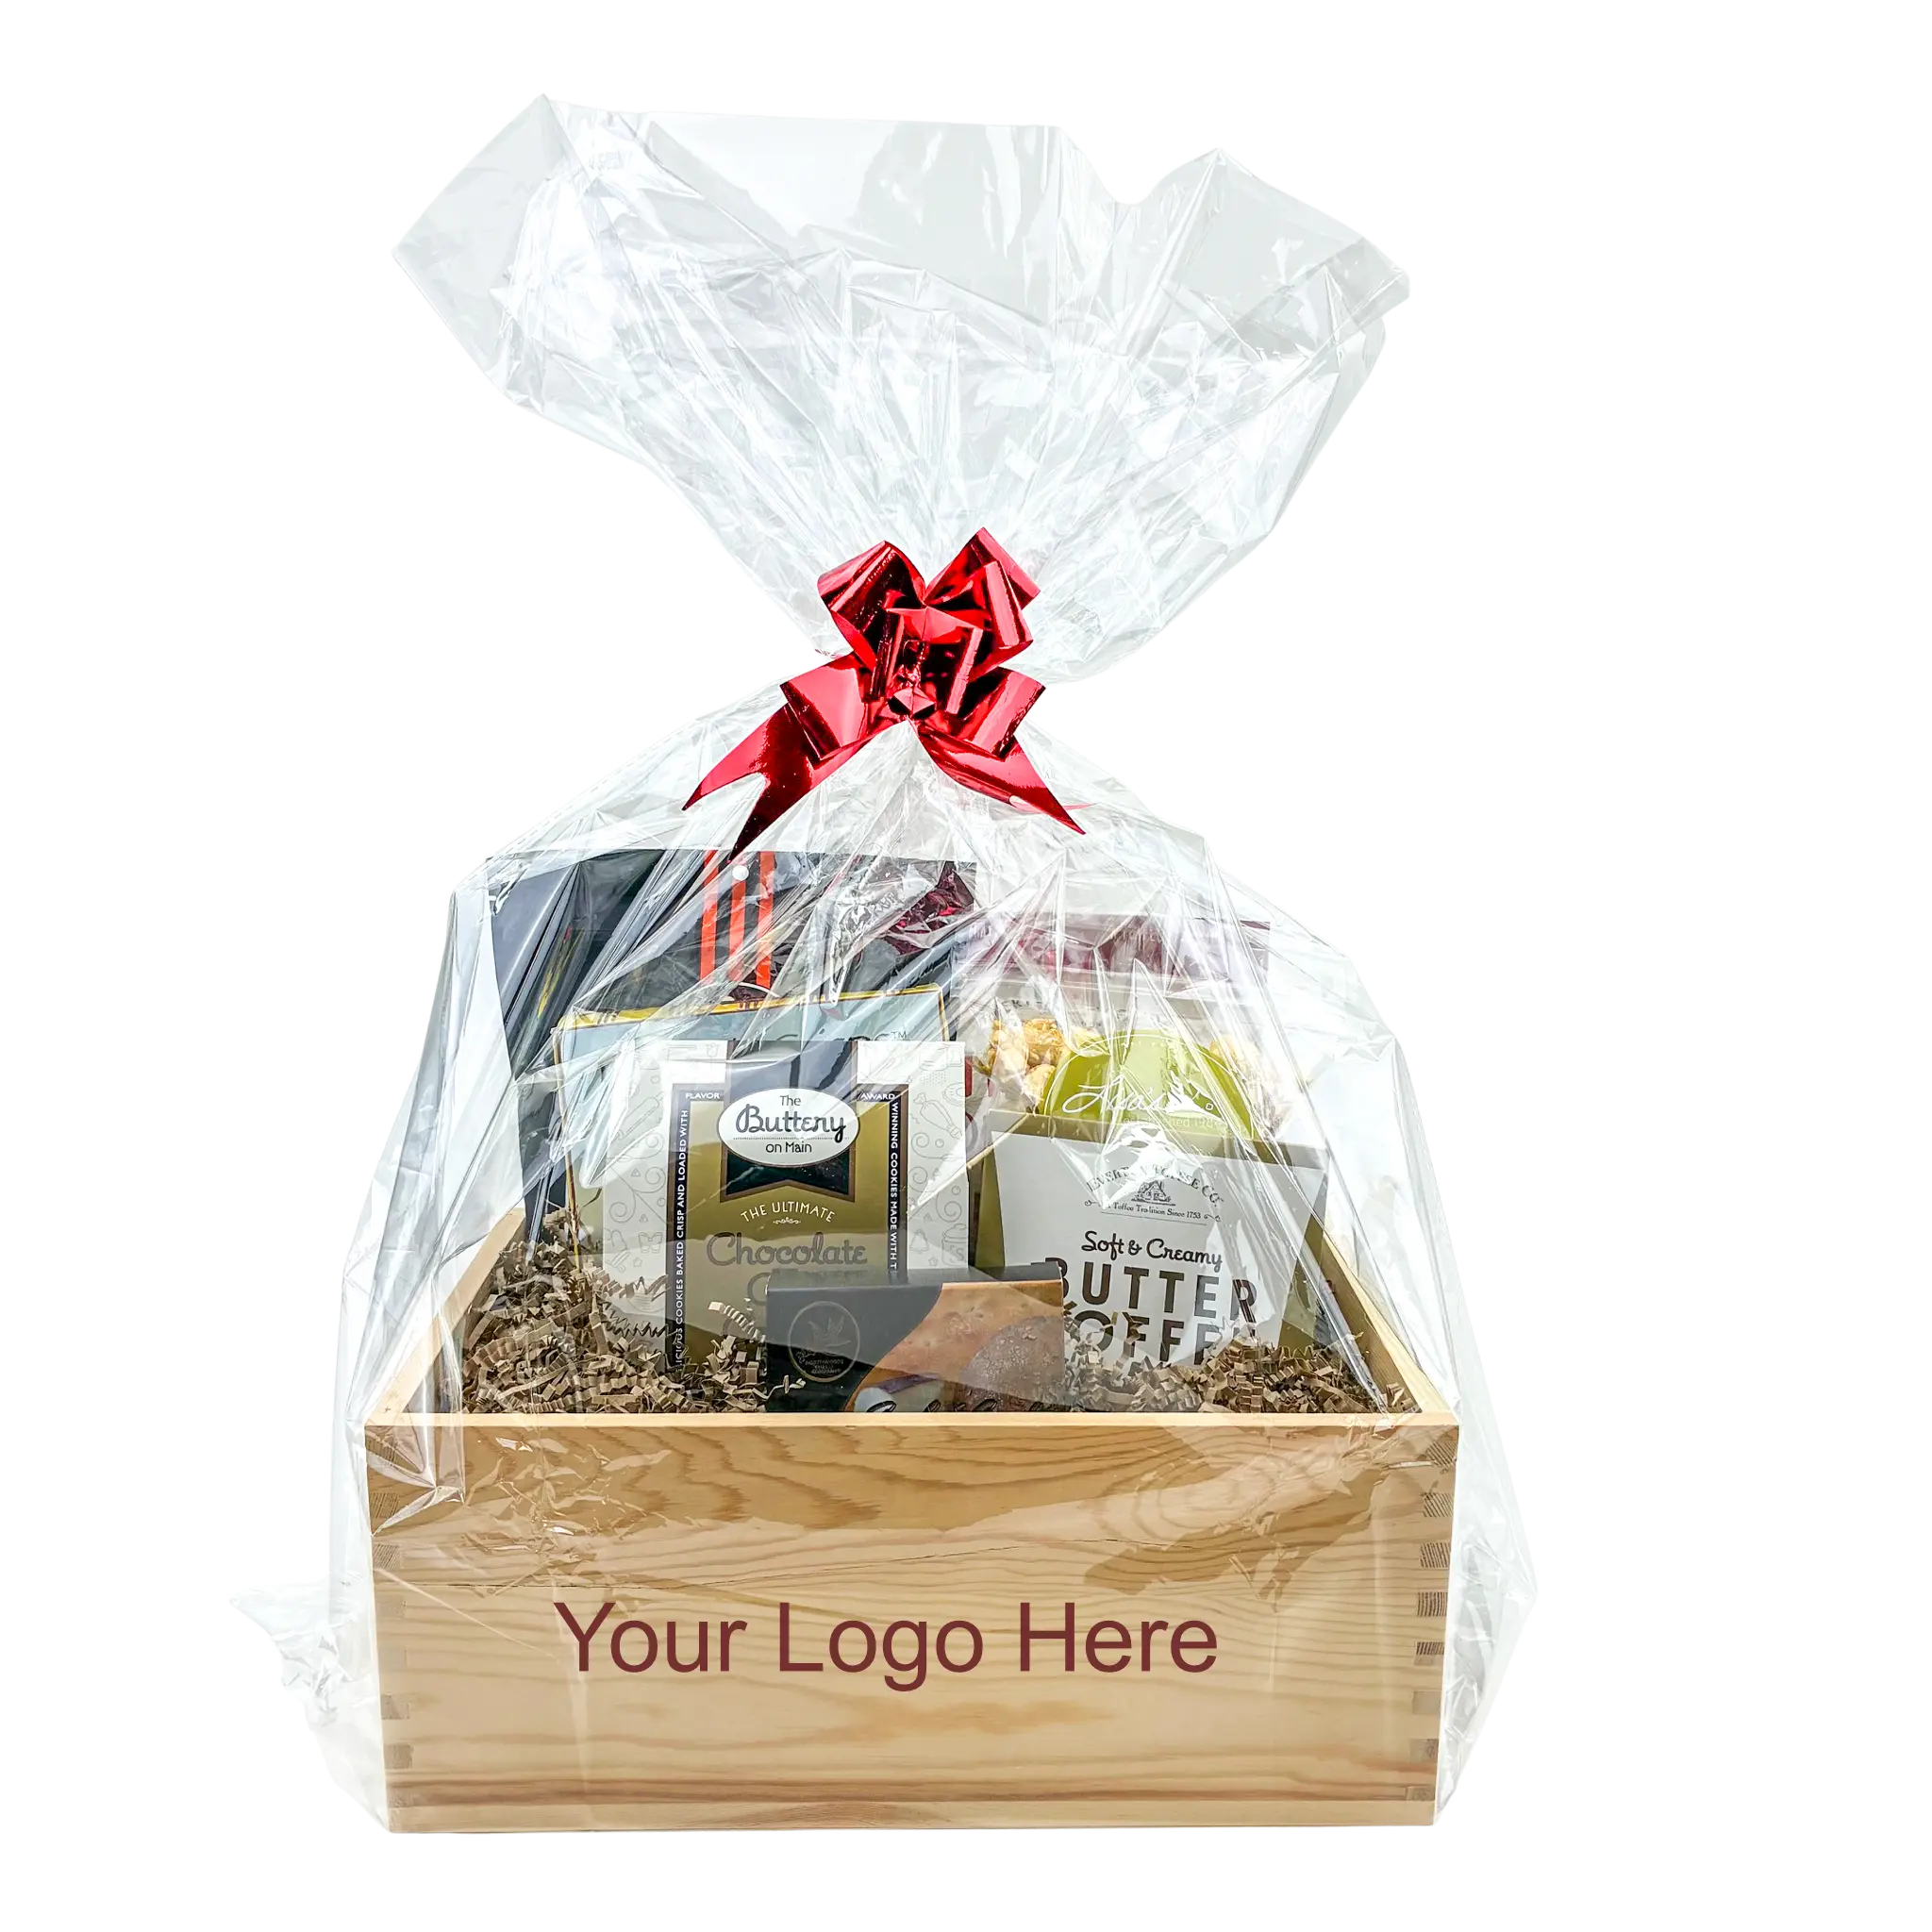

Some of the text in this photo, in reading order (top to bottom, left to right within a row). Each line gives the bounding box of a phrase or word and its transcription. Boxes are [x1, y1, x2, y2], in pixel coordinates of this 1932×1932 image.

[779, 1094, 802, 1107] The
[679, 1109, 689, 1138] WITH
[735, 1103, 847, 1143] Buttery
[891, 1102, 899, 1149] WINNING
[678, 1139, 687, 1181] LOADED
[765, 1141, 812, 1154] on Main
[890, 1153, 898, 1199] COOKIES
[676, 1184, 686, 1208] AND
[676, 1209, 685, 1239] CRISP
[741, 1201, 836, 1224] THE ULTIMATE
[890, 1200, 898, 1230] MADE
[1167, 1208, 1185, 1218] Since
[1186, 1209, 1202, 1220] 1753
[675, 1241, 684, 1275] BAKED
[707, 1231, 868, 1267] Chocolate
[1081, 1230, 1223, 1273] Soft & Creamy
[675, 1279, 684, 1324] COOKIES
